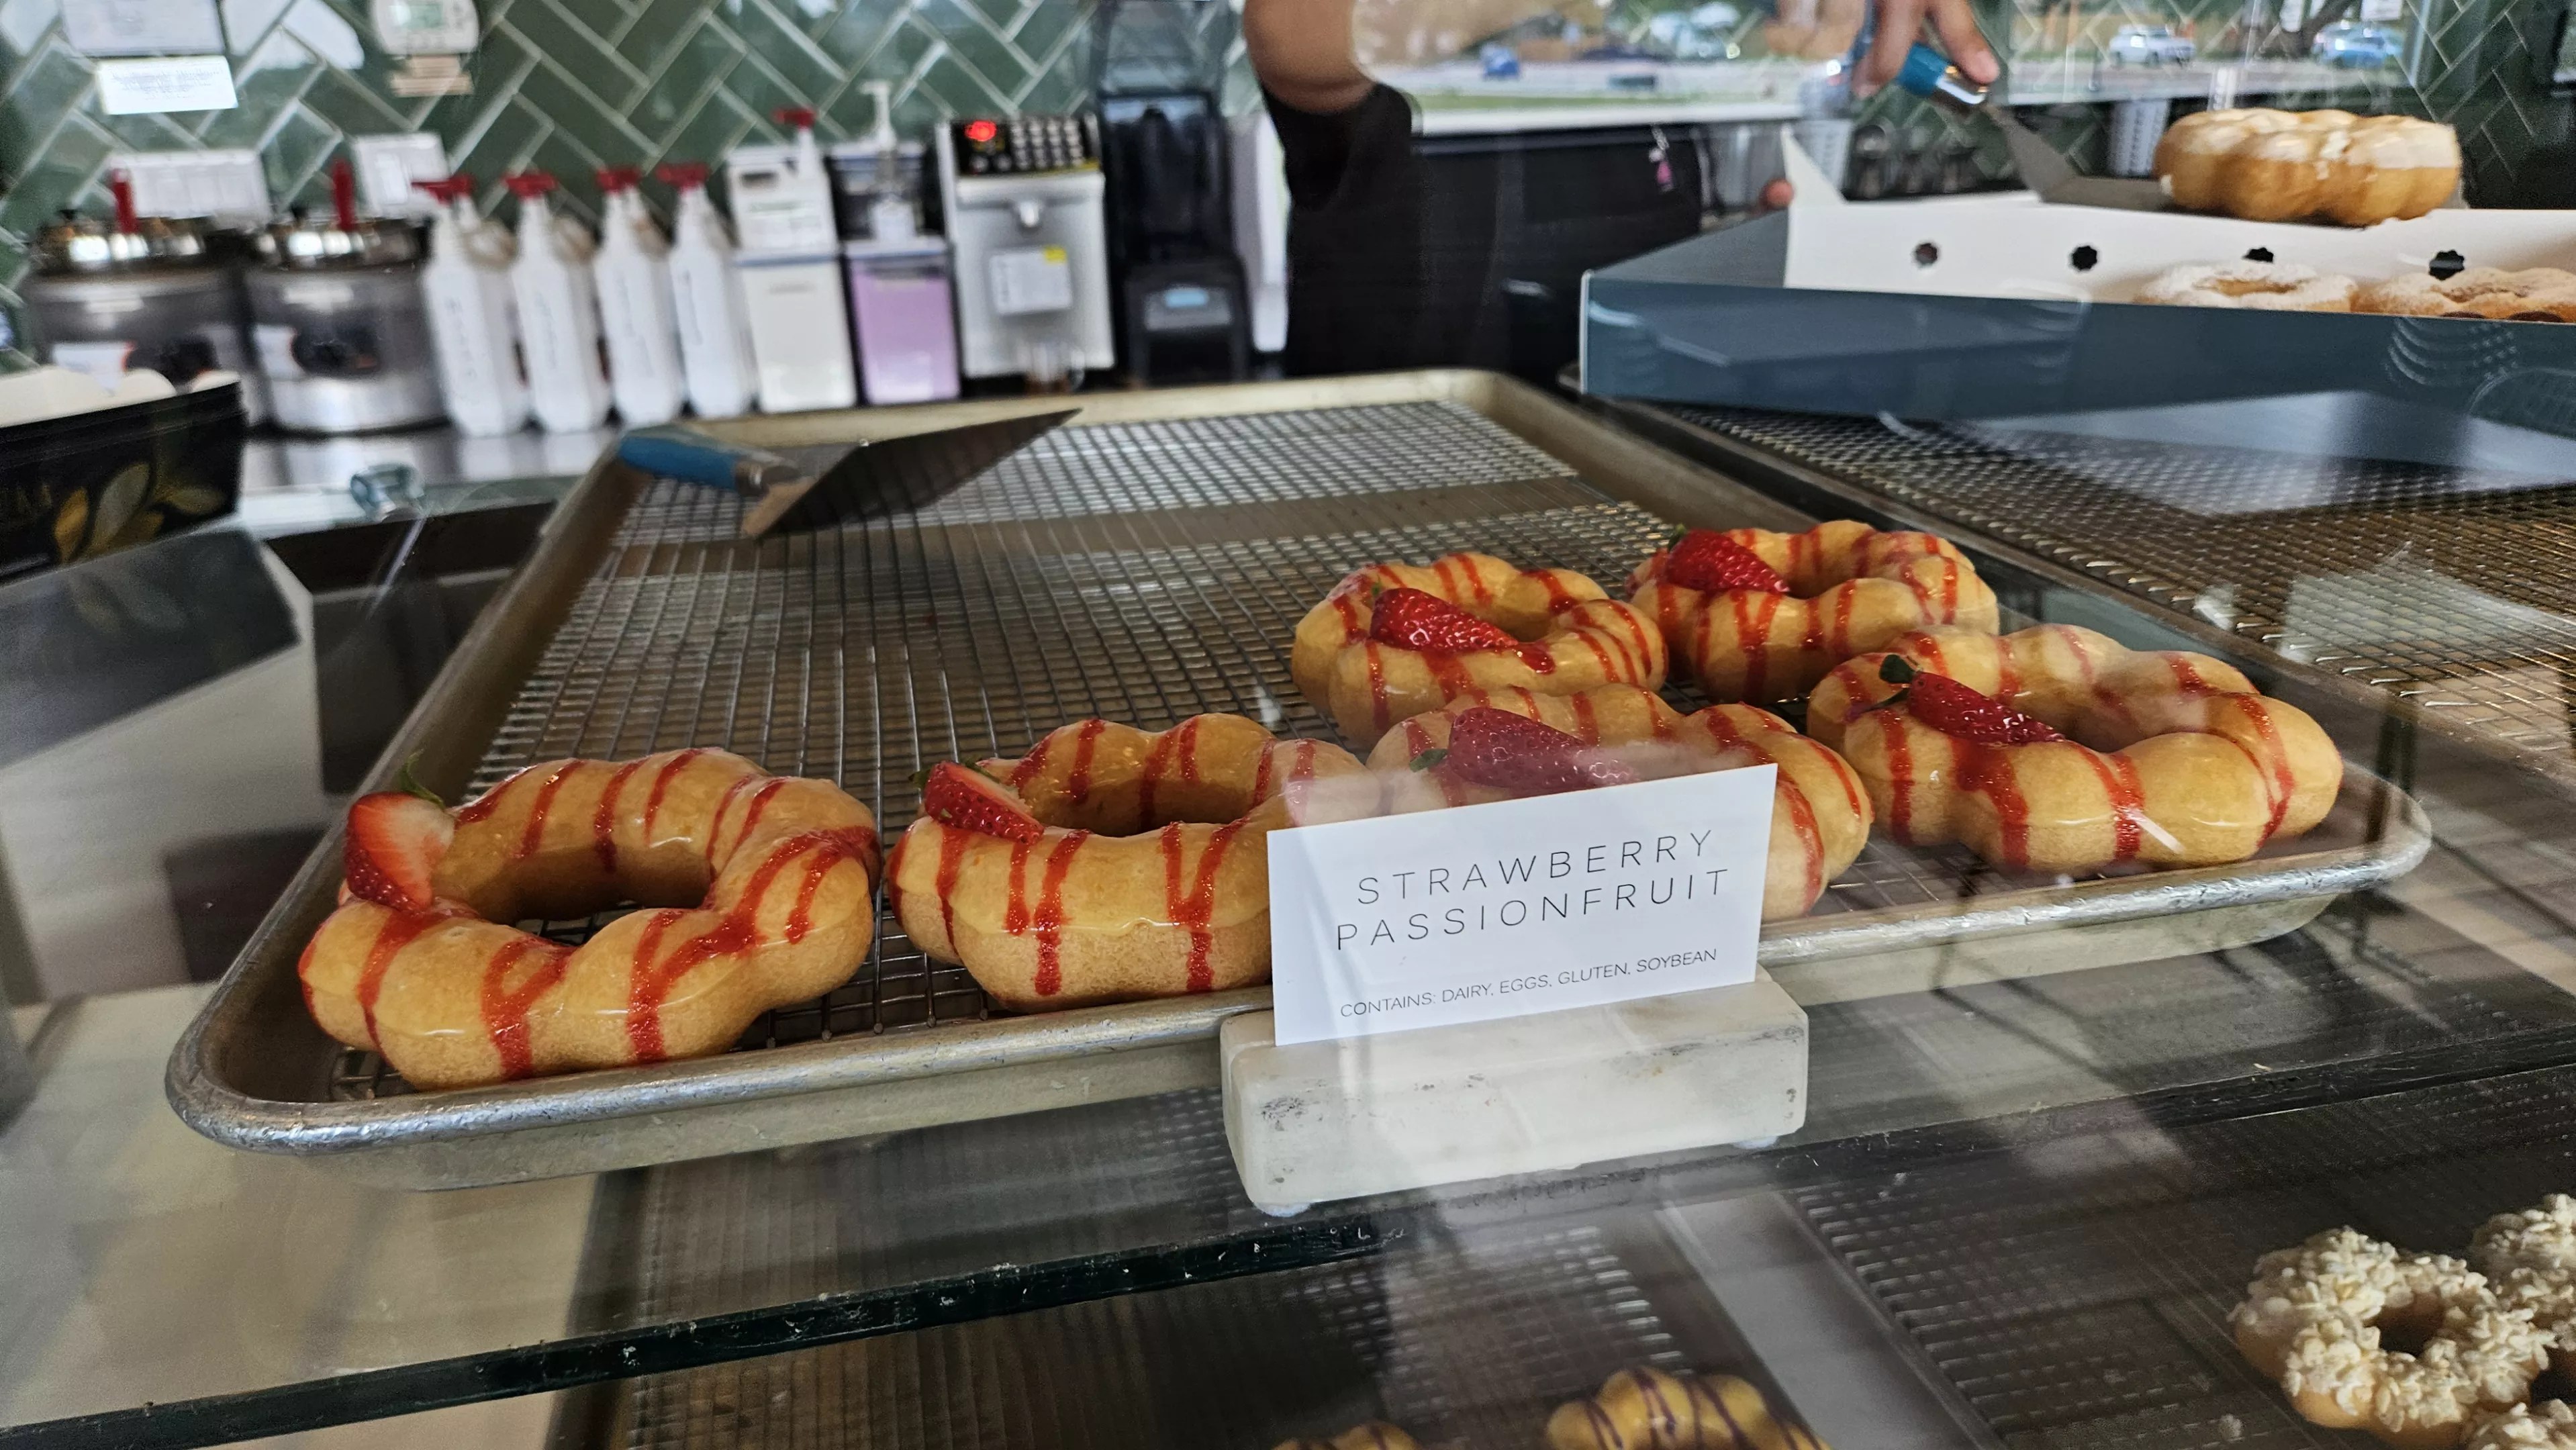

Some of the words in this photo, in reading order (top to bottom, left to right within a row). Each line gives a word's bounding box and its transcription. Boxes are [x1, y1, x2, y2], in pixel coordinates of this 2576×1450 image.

[1357, 830, 1711, 905] STRAWBERRY
[1337, 869, 1728, 951] PASSIONFRUIT
[1341, 992, 1436, 1017] CONTAINS:
[1636, 948, 1717, 973] SOYBEAN
